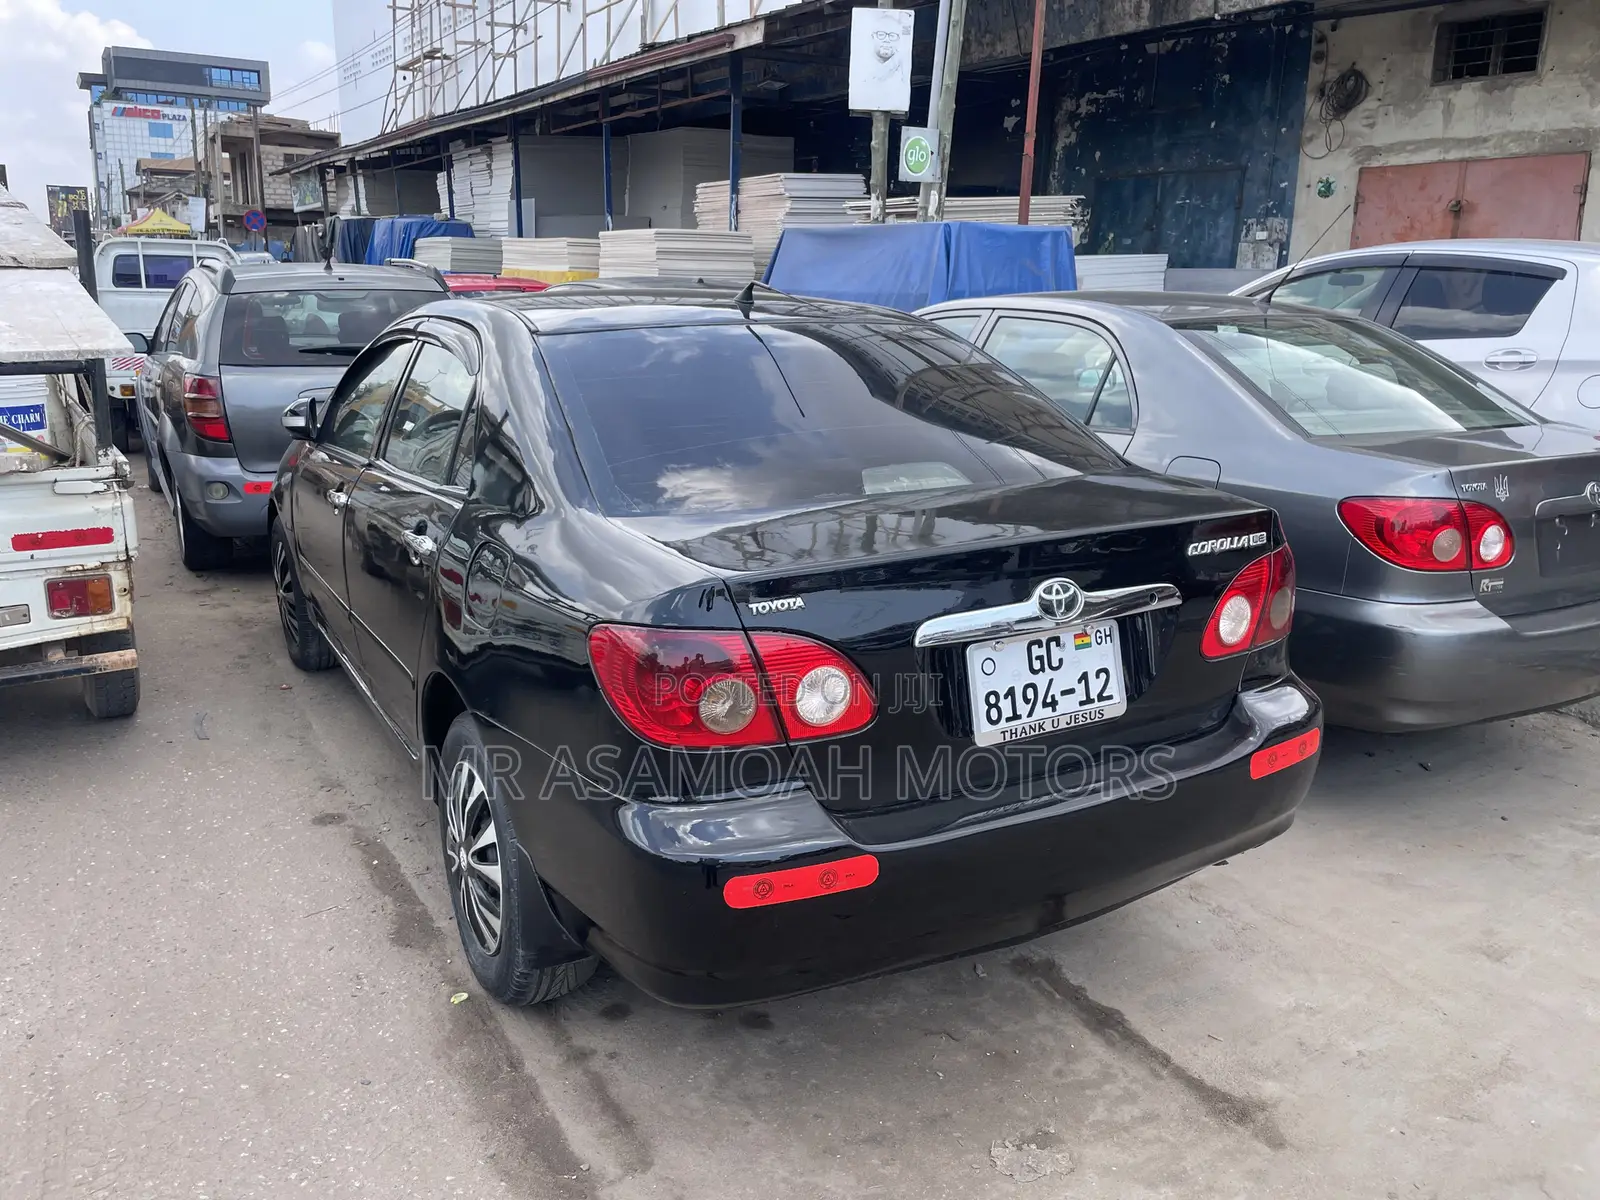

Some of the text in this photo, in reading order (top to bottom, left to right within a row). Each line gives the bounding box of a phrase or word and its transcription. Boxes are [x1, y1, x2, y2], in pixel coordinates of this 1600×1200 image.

[161, 113, 187, 121] PLAZA
[907, 146, 926, 165] glo
[11, 412, 41, 425] CHARM
[1461, 482, 1488, 492] TOYOTA
[749, 597, 805, 615] TOYOTA
[1026, 627, 1113, 675] GC GH
[984, 667, 1114, 726] 8194-12
[1000, 708, 1105, 742] THANK U JESUS
